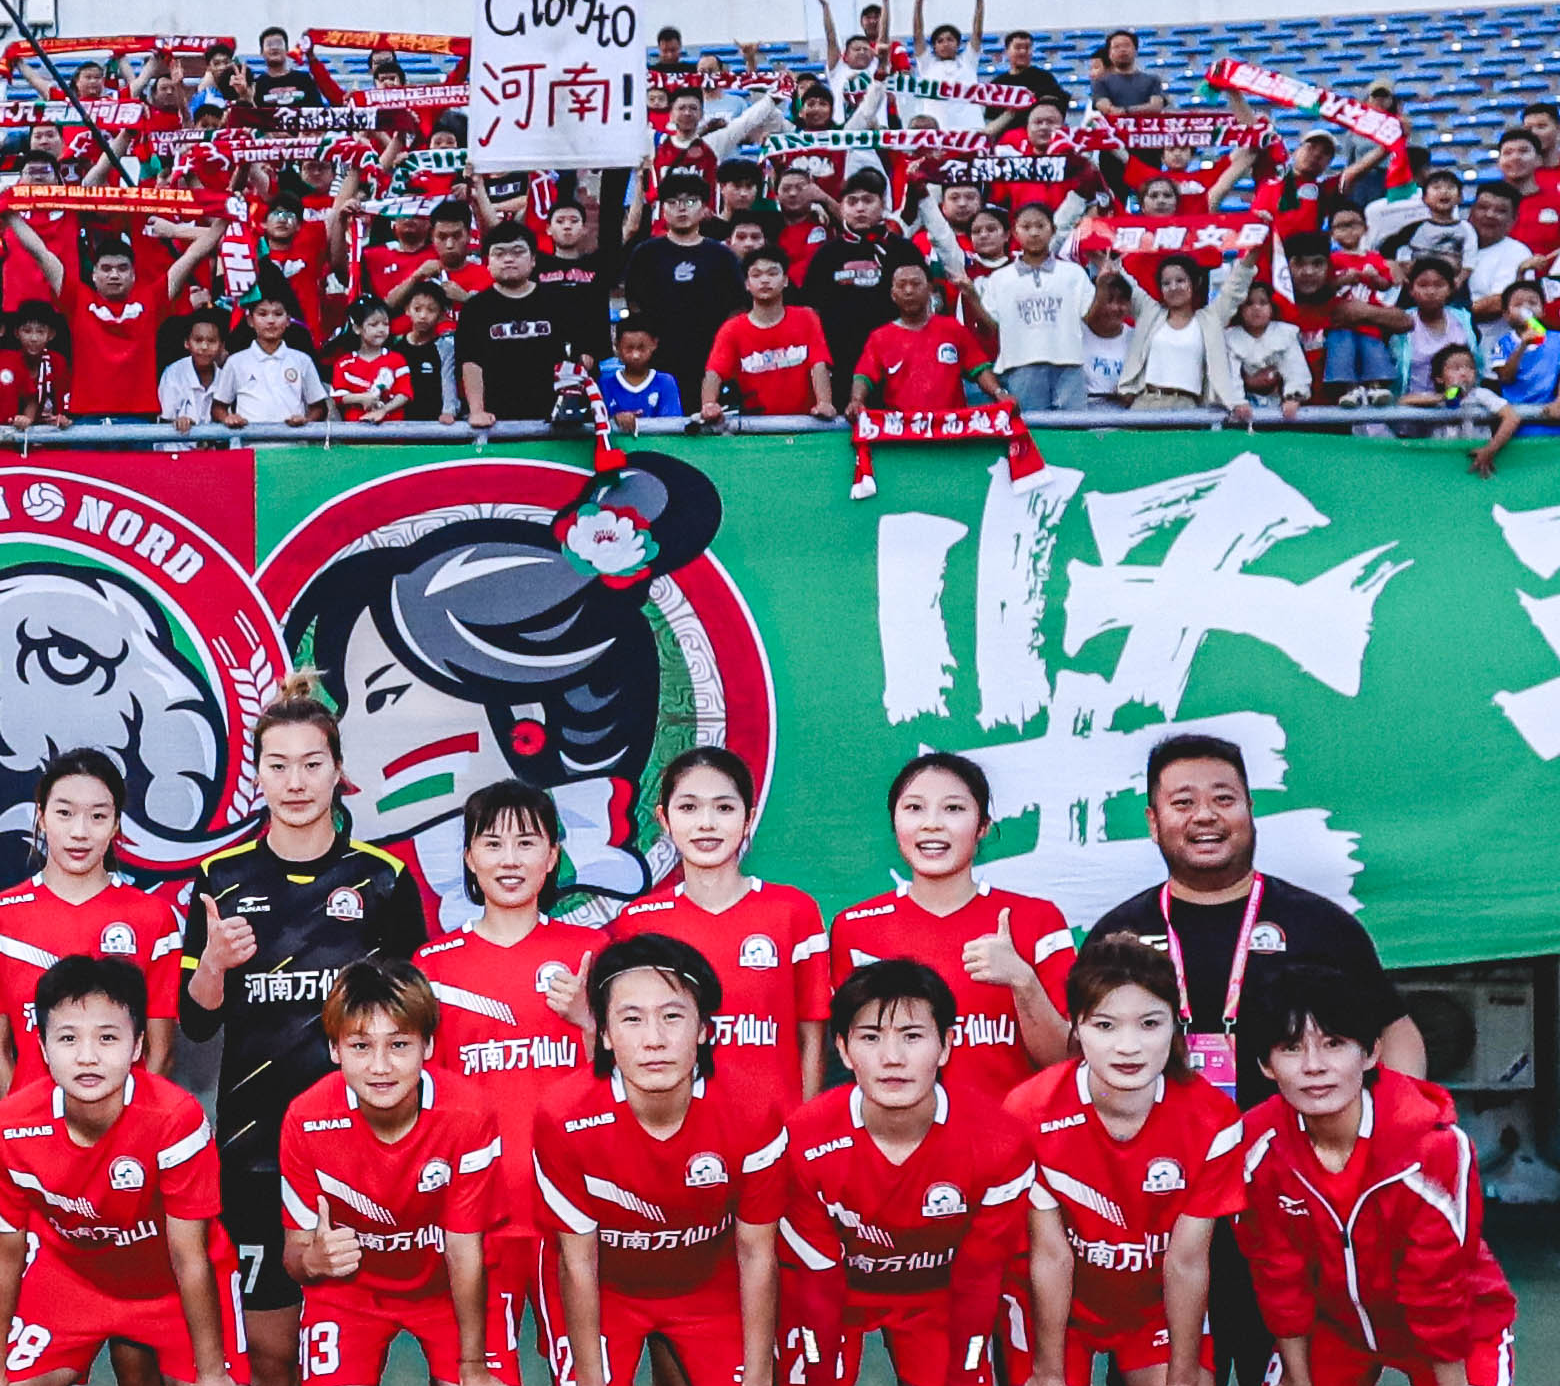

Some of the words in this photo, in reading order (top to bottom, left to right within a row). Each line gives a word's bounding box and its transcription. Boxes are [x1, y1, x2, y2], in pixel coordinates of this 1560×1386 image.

[592, 1, 636, 48] to
[72, 493, 206, 585] NORD
[457, 1035, 578, 1077] 河南万仙山
[3, 1125, 54, 1140] SUNAIS
[302, 1117, 353, 1133] SUNAIS
[564, 1112, 615, 1133] SUNAIS
[803, 1135, 854, 1162] SUNAIS
